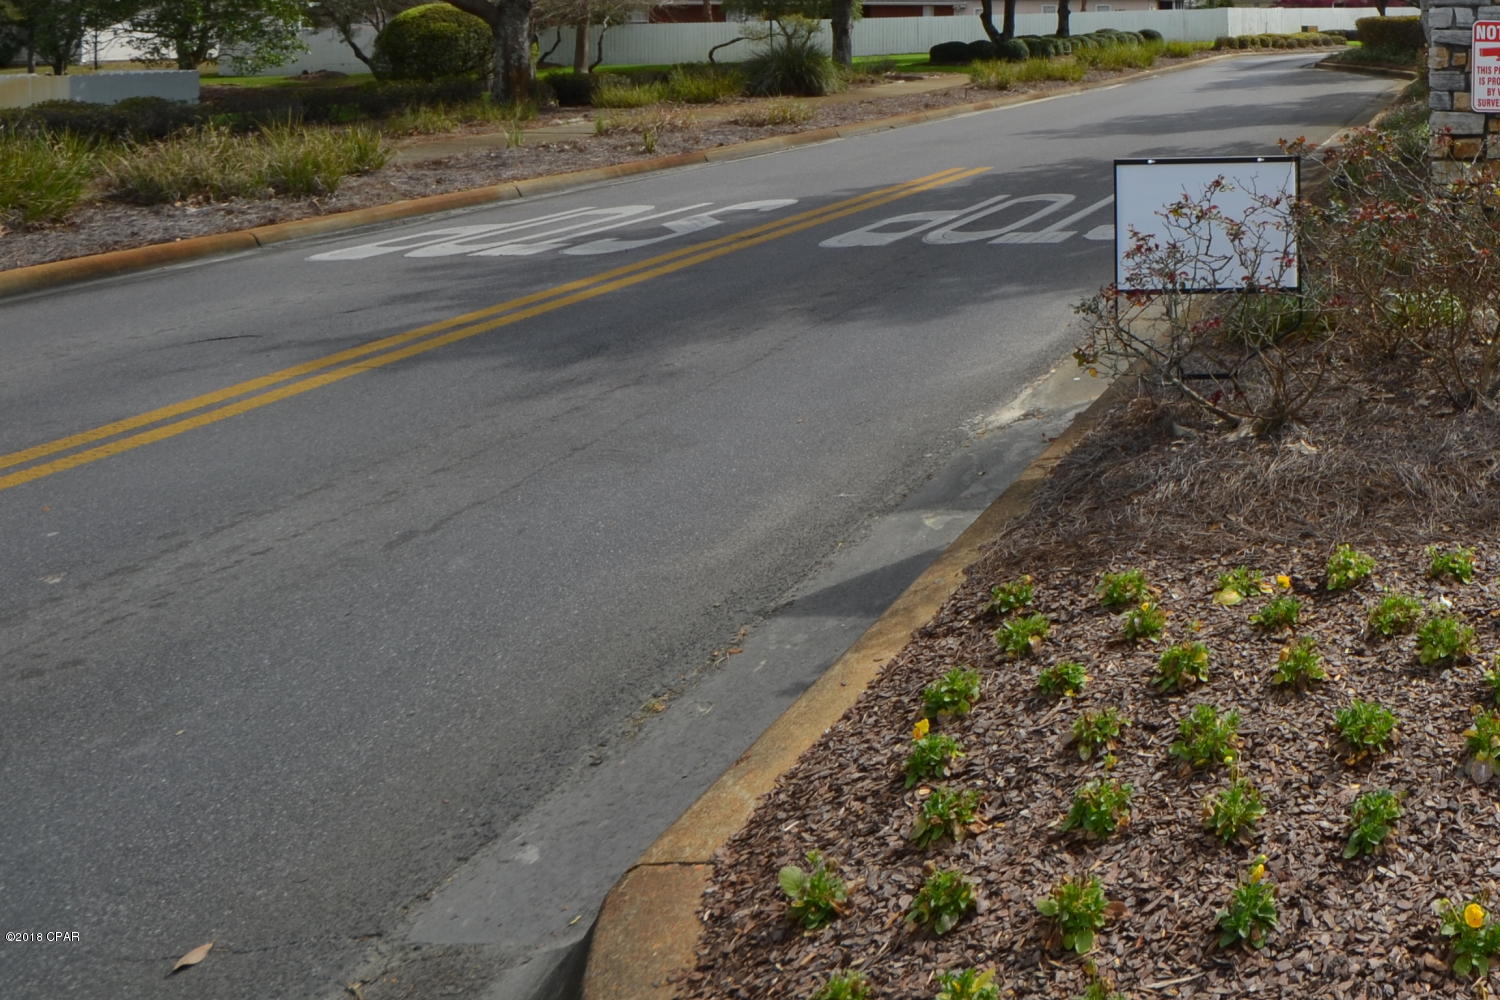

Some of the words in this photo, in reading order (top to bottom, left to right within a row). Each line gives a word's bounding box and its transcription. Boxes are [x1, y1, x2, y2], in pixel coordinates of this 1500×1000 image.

[1477, 66, 1491, 75] THIS
[1479, 77, 1485, 85] IS
[1487, 88, 1496, 96] BY
[819, 194, 1114, 247] TOP
[305, 199, 799, 261] STOP
